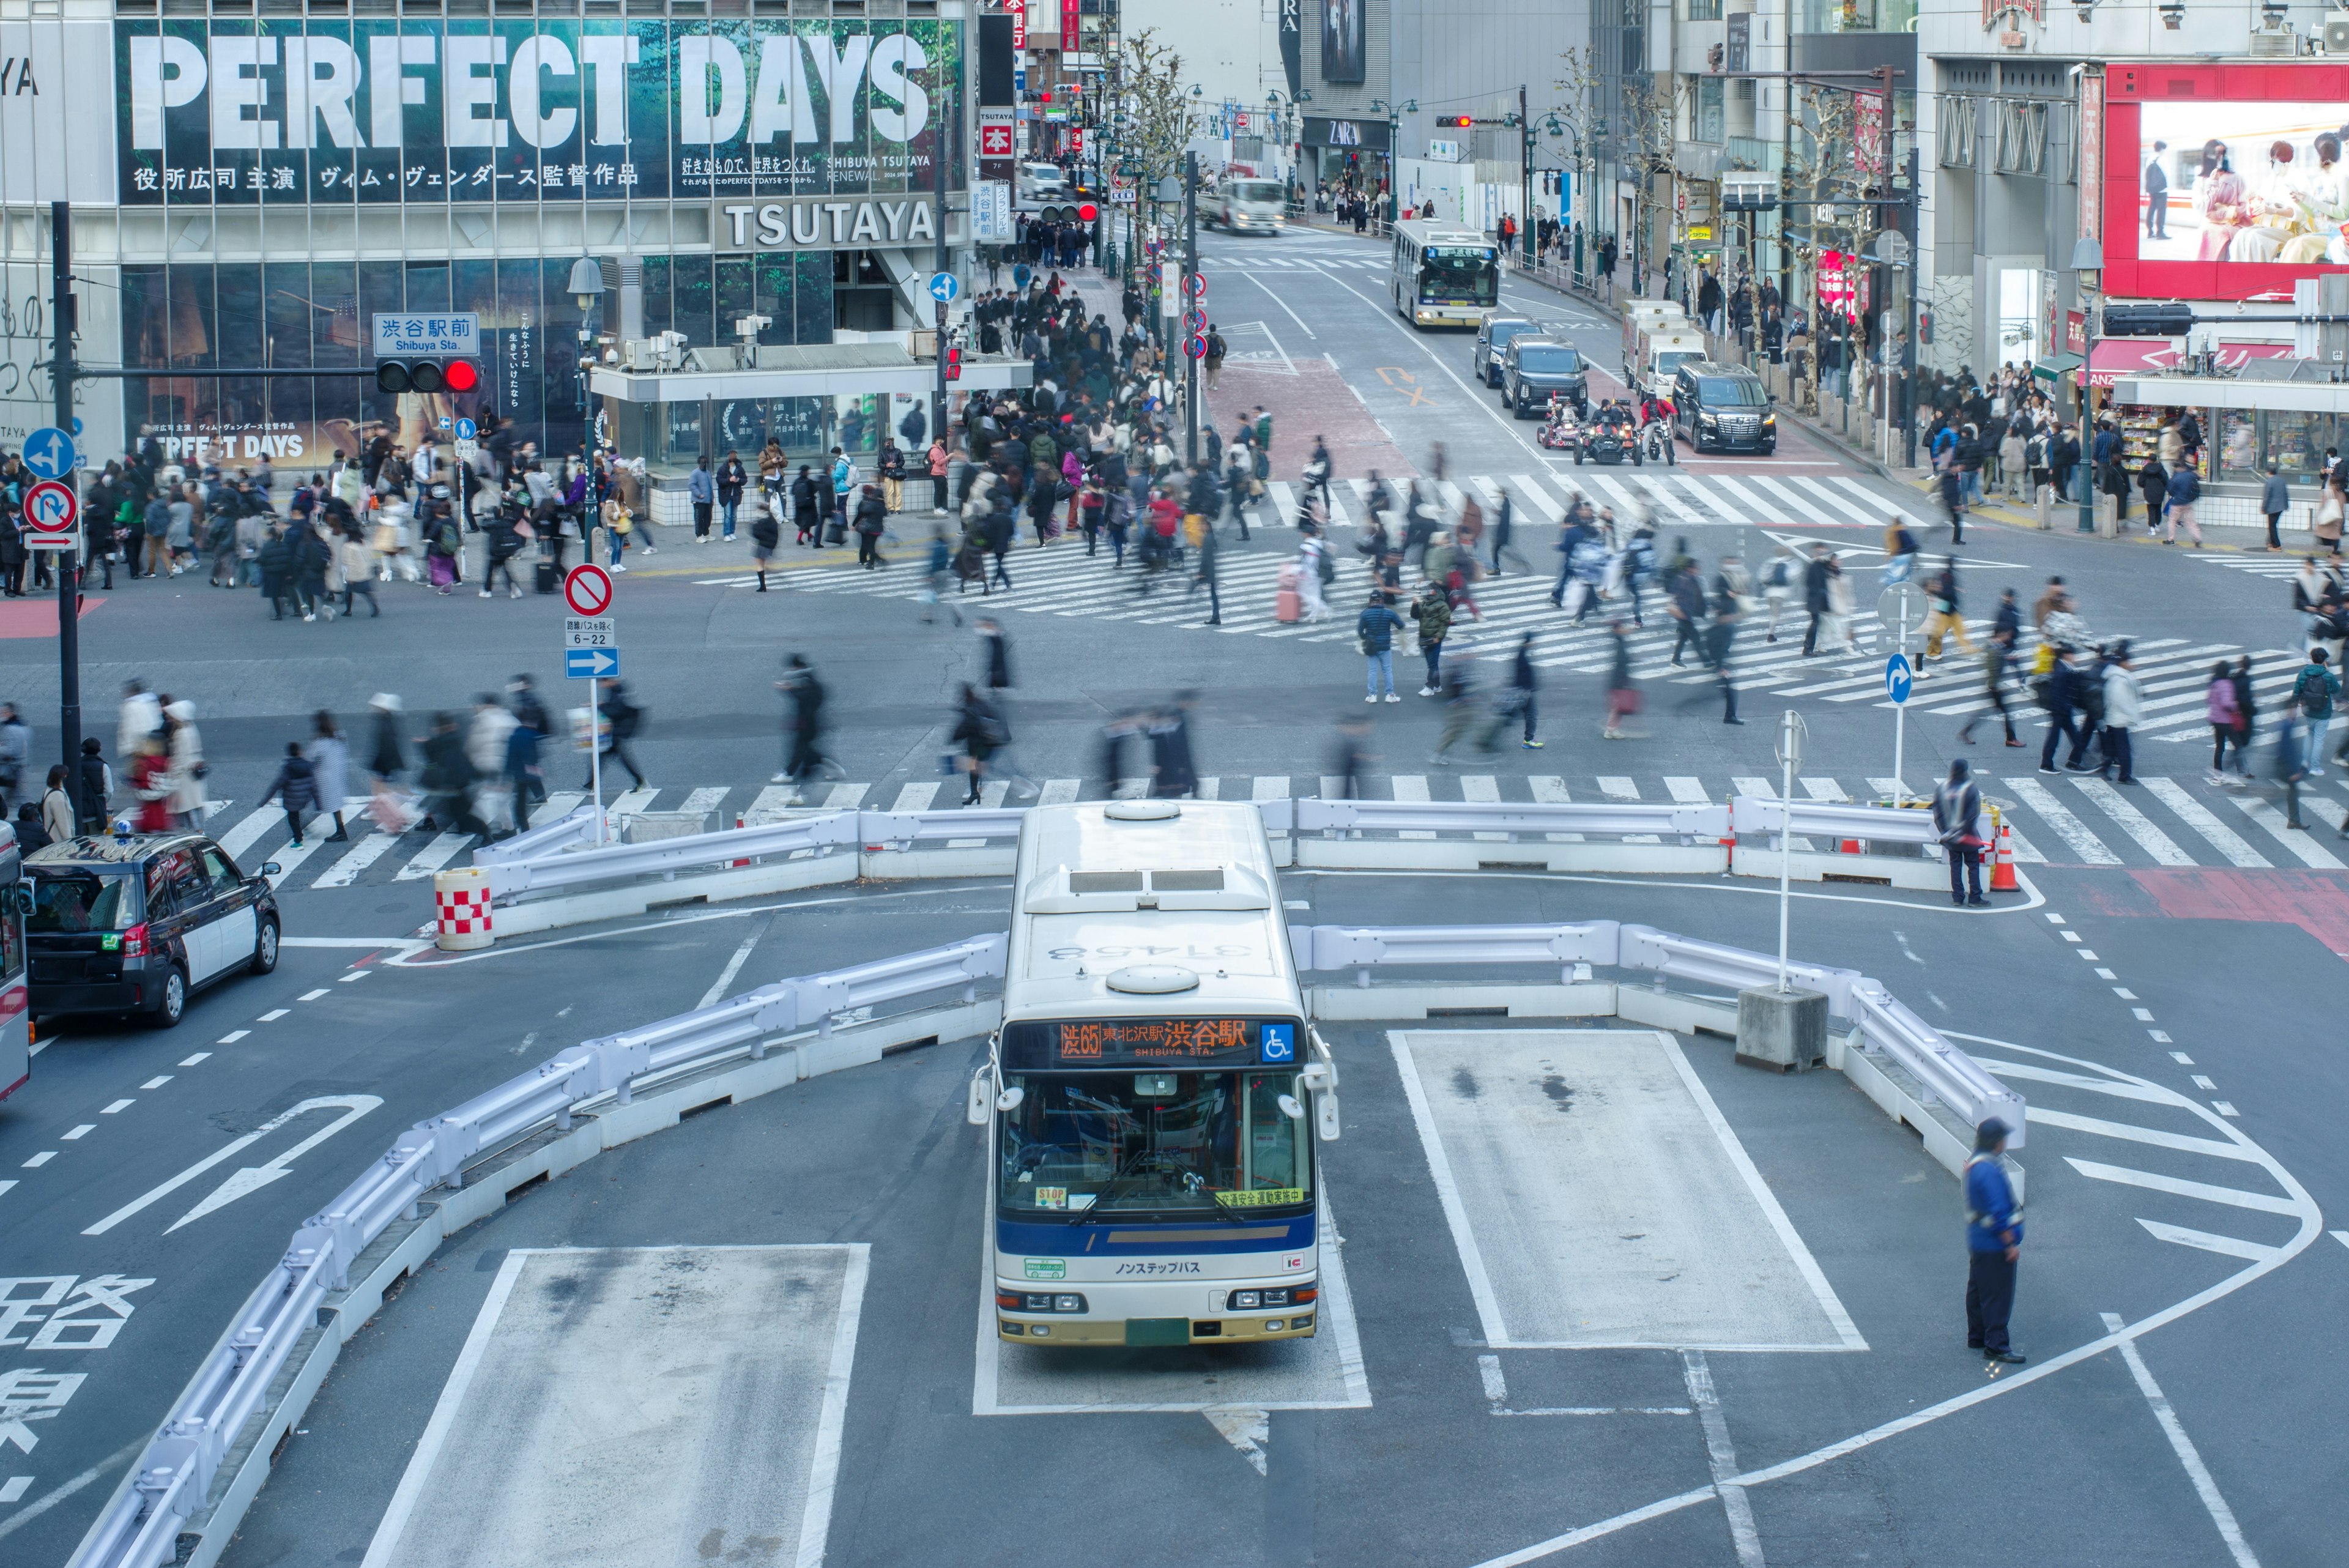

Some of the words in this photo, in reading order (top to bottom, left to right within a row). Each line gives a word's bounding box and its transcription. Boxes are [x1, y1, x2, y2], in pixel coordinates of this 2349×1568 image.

[130, 35, 639, 150] PERFECT
[680, 34, 929, 144] DAYS
[985, 128, 1009, 152] 本
[1330, 121, 1359, 146] ZARA
[827, 157, 877, 168] SHIBUYA
[881, 155, 930, 167] TSUTAYA
[134, 166, 237, 191] 役所広司
[247, 166, 295, 190] 主演
[320, 163, 638, 189] ヴィム・ヴェンダース監督作品
[981, 186, 991, 234] 渋谷駅前
[998, 187, 1007, 233] スクランブル式
[724, 201, 937, 246] TSUTAYA
[383, 319, 470, 338] 渋谷駅前
[521, 313, 530, 368] こんなふうに
[396, 341, 436, 352] Shibuya
[440, 340, 460, 349] Sta.
[509, 333, 519, 407] 生きていけたなら
[245, 434, 303, 458] DAYS
[566, 621, 611, 631] 路線バスを除く
[574, 634, 605, 644] 6-22
[1102, 1025, 1164, 1042] 東北沢駅
[1165, 1020, 1246, 1047] 渋谷駅
[1039, 1189, 1064, 1198] STOP
[1222, 1192, 1255, 1206] 交通安全
[1257, 1189, 1299, 1205] 運動実施中
[1116, 1261, 1200, 1274] ノンステップバス
